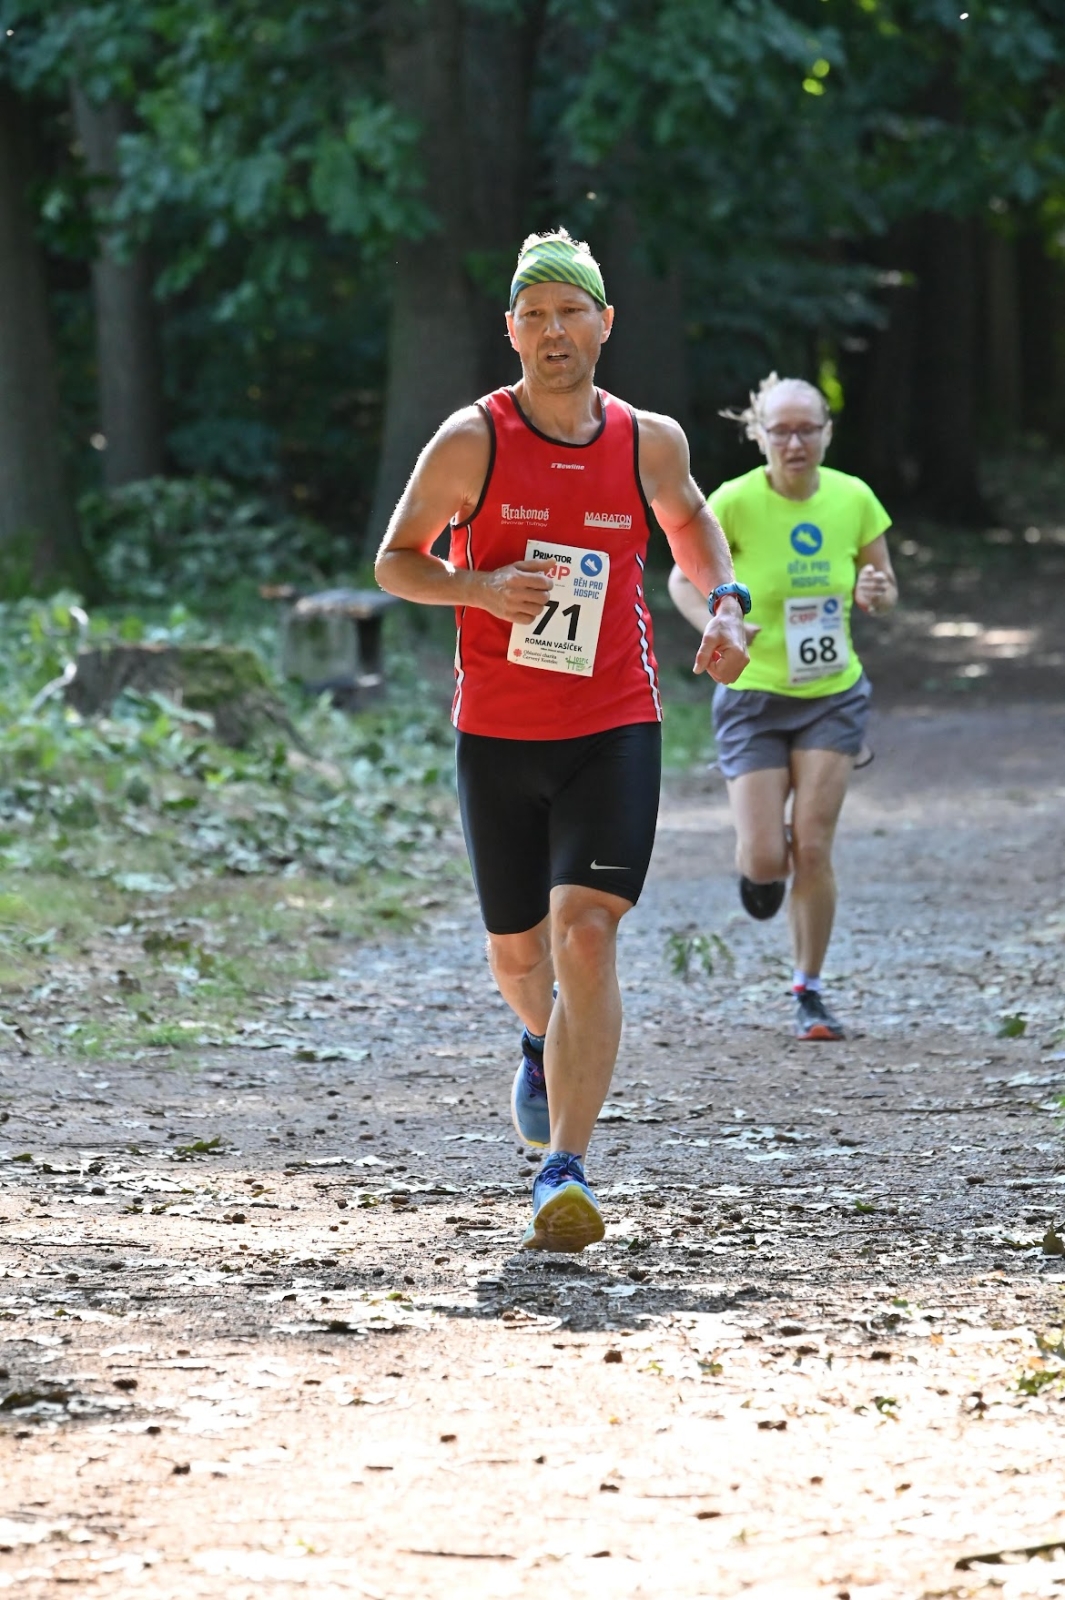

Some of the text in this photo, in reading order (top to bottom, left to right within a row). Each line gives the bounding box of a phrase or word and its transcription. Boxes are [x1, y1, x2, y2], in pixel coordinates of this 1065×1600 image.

[501, 503, 550, 521] Krakonoš
[584, 511, 632, 524] MARATON
[573, 576, 588, 588] BĚH
[588, 580, 604, 591] PRO
[573, 587, 600, 600] HOSPIC
[532, 600, 582, 641] 71
[524, 637, 553, 648] ROMAN
[553, 640, 583, 653] VAŠÍČEK
[799, 635, 838, 666] 68
